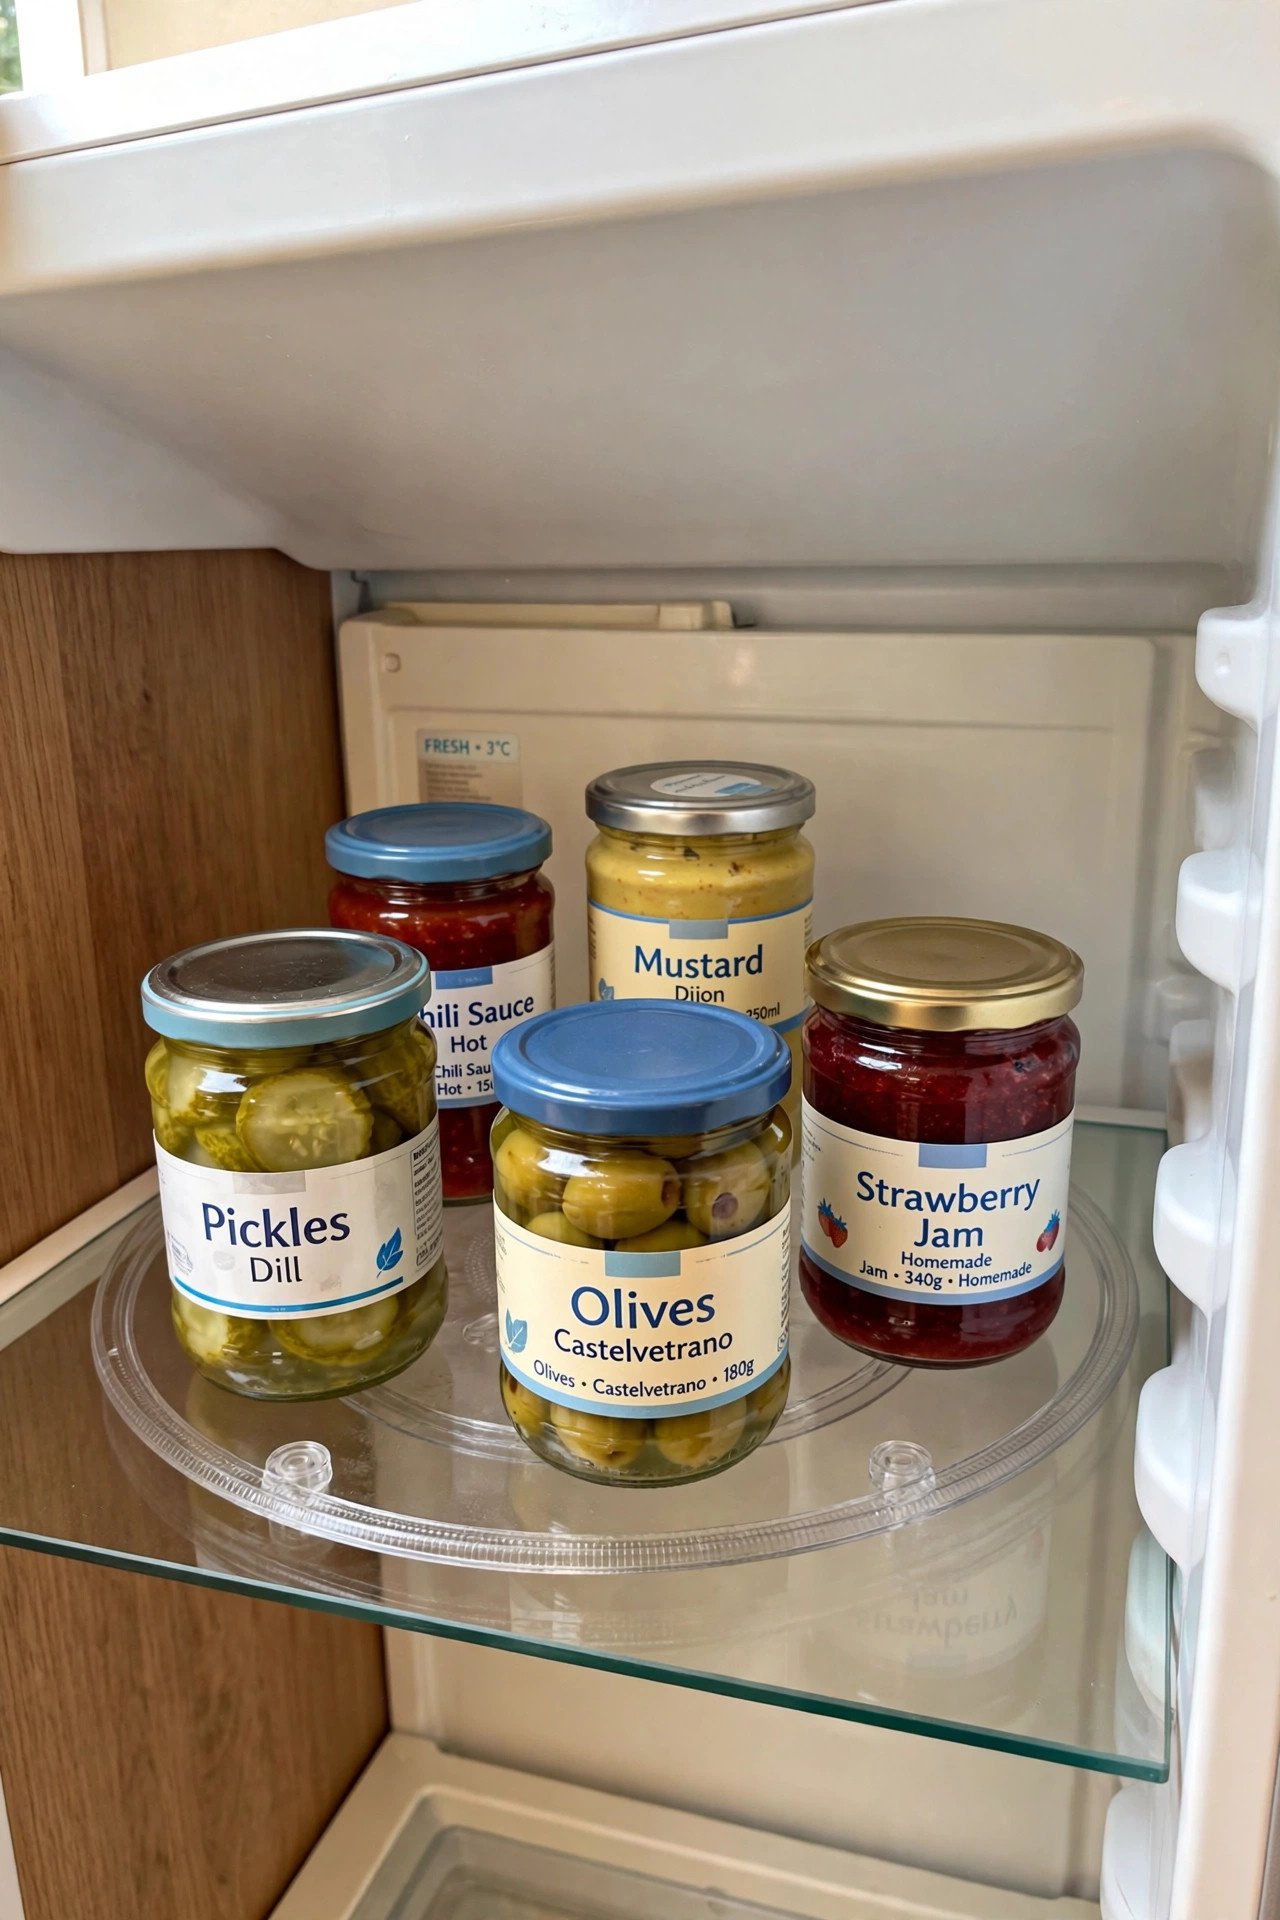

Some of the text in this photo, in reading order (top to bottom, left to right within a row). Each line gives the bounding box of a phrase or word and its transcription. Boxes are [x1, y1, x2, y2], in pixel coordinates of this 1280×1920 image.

[424, 737, 510, 756] FRESH 3°C
[634, 944, 763, 979] Mustard
[419, 996, 534, 1029] hili Sauce
[450, 1035, 487, 1053] Hot
[466, 1062, 491, 1076] Sau
[437, 1082, 462, 1096] Hot
[856, 1171, 1041, 1214] Strawberry
[201, 1202, 351, 1248] Pickles
[913, 1218, 983, 1249] Jam
[249, 1256, 303, 1283] Dill
[859, 1260, 1032, 1291] Jam 340g Homemade
[900, 1251, 993, 1270] Homemade
[570, 1285, 716, 1329] Olives
[554, 1328, 733, 1363] Castelvetrano
[533, 1357, 755, 1398] Olives Castelvetrano 180g
